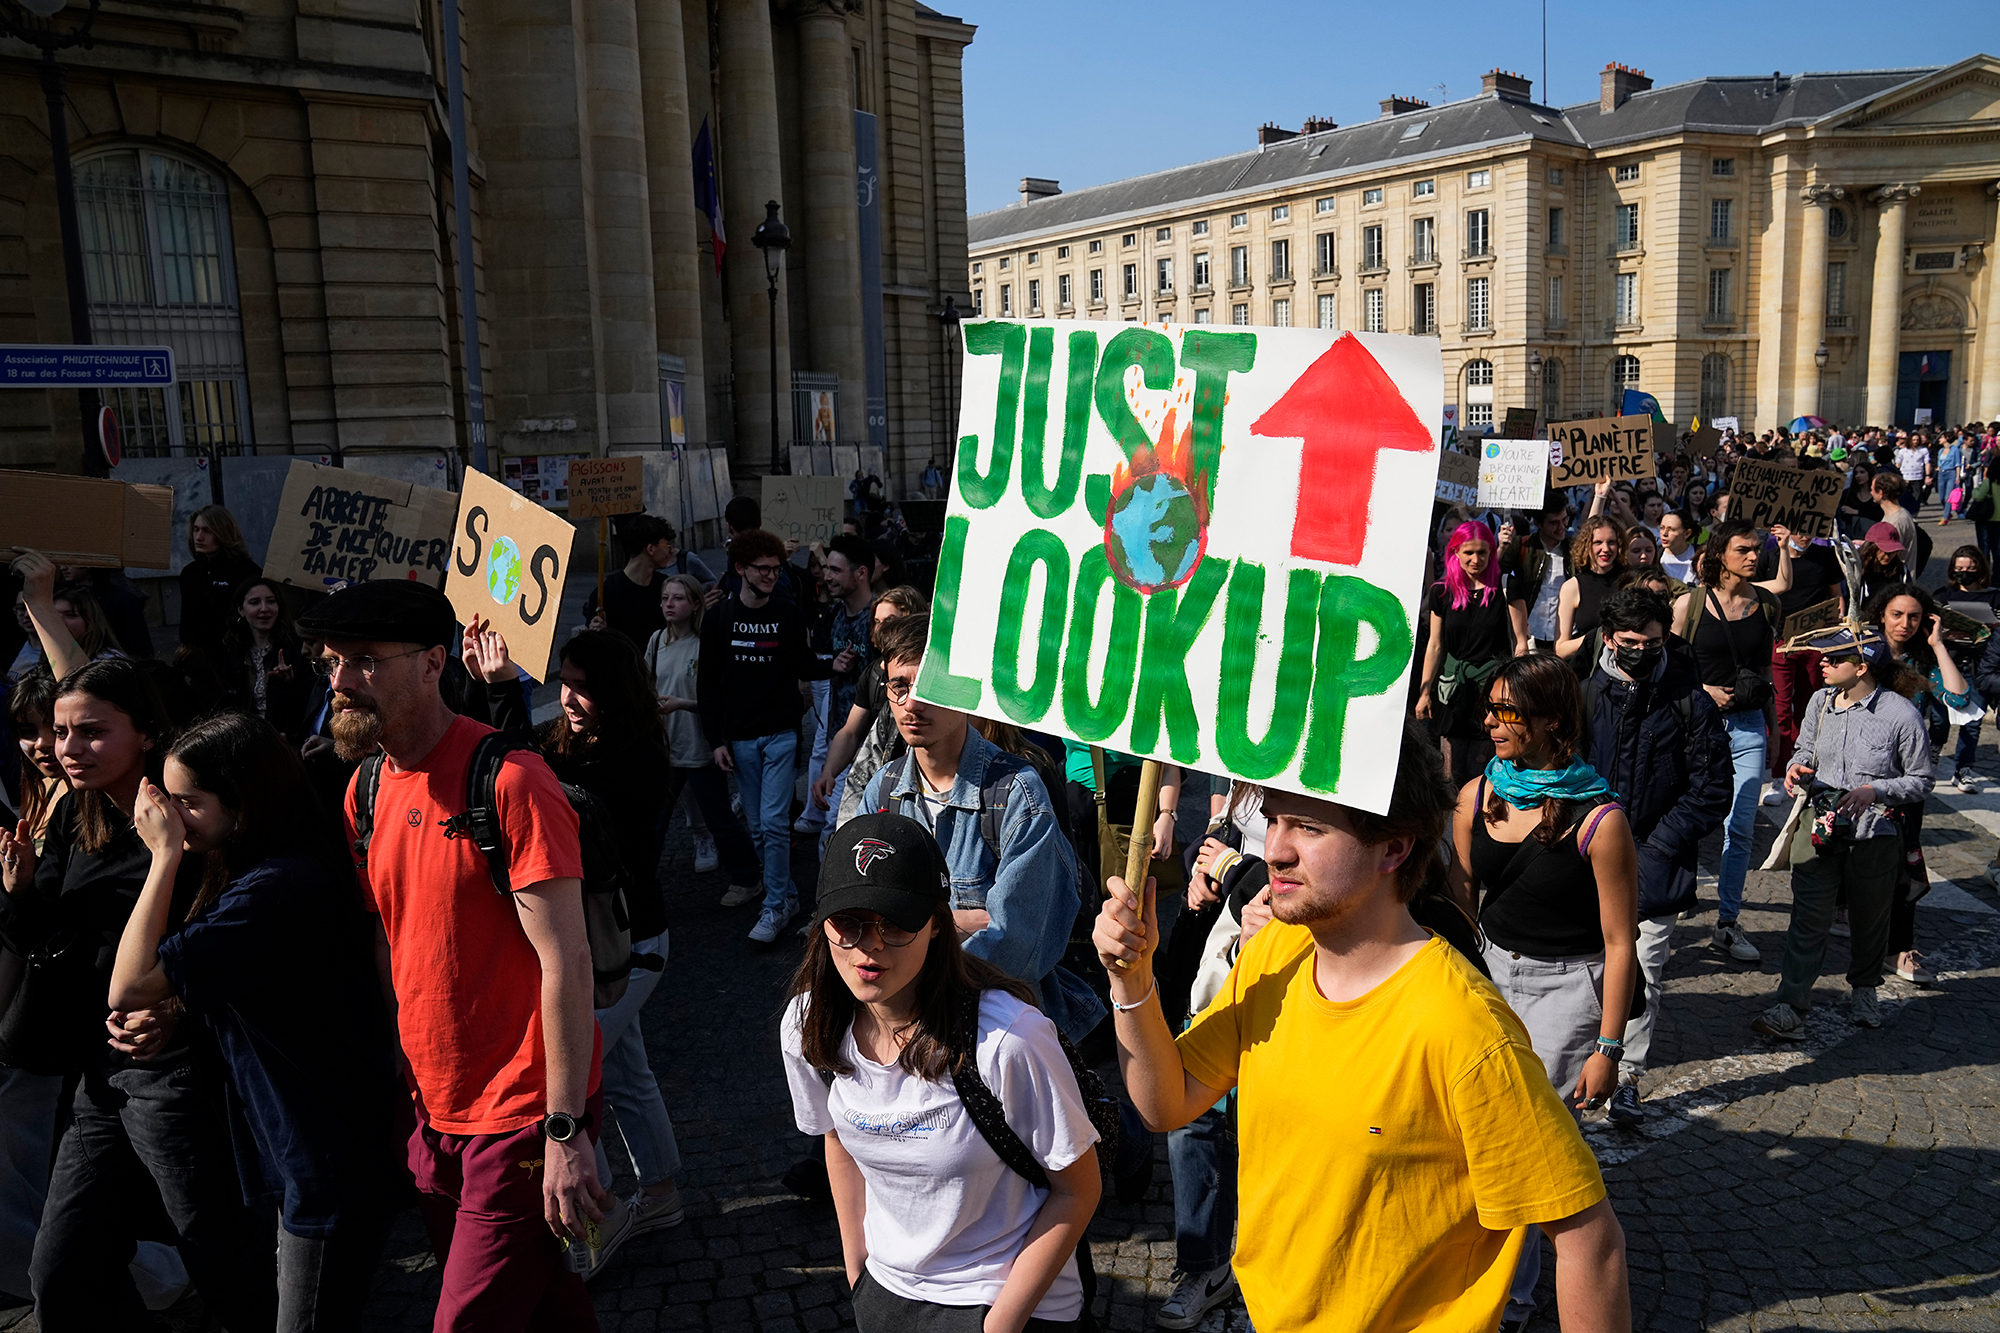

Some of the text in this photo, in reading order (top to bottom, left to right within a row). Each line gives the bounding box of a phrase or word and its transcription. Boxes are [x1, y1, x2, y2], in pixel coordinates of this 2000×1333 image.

[1918, 207, 1953, 216] ÉGALITÉ
[4, 355, 140, 365] Association PHILOTECHNIQUE
[7, 369, 142, 379] 18 rue des Fosses St Jacques
[957, 320, 1257, 527] JUST
[1552, 427, 1567, 441] LA
[1570, 424, 1649, 457] PLANÈTE
[1501, 445, 1535, 460] YOU'RE
[1557, 455, 1647, 481] SOUFFRE
[580, 477, 605, 486] AVANT
[1498, 474, 1523, 484] OUR
[1738, 461, 1841, 495] RÉCHAUFFEZ NOS
[571, 489, 582, 497] LA
[591, 494, 612, 503] NOIE
[1488, 486, 1532, 501] HEART
[1792, 491, 1820, 509] PAS
[812, 507, 835, 521] THE
[1727, 496, 1742, 520] LA
[306, 521, 337, 546] DE
[1790, 603, 1836, 631] TERRE
[733, 623, 779, 634] TOMMY
[734, 654, 773, 662] SPORT
